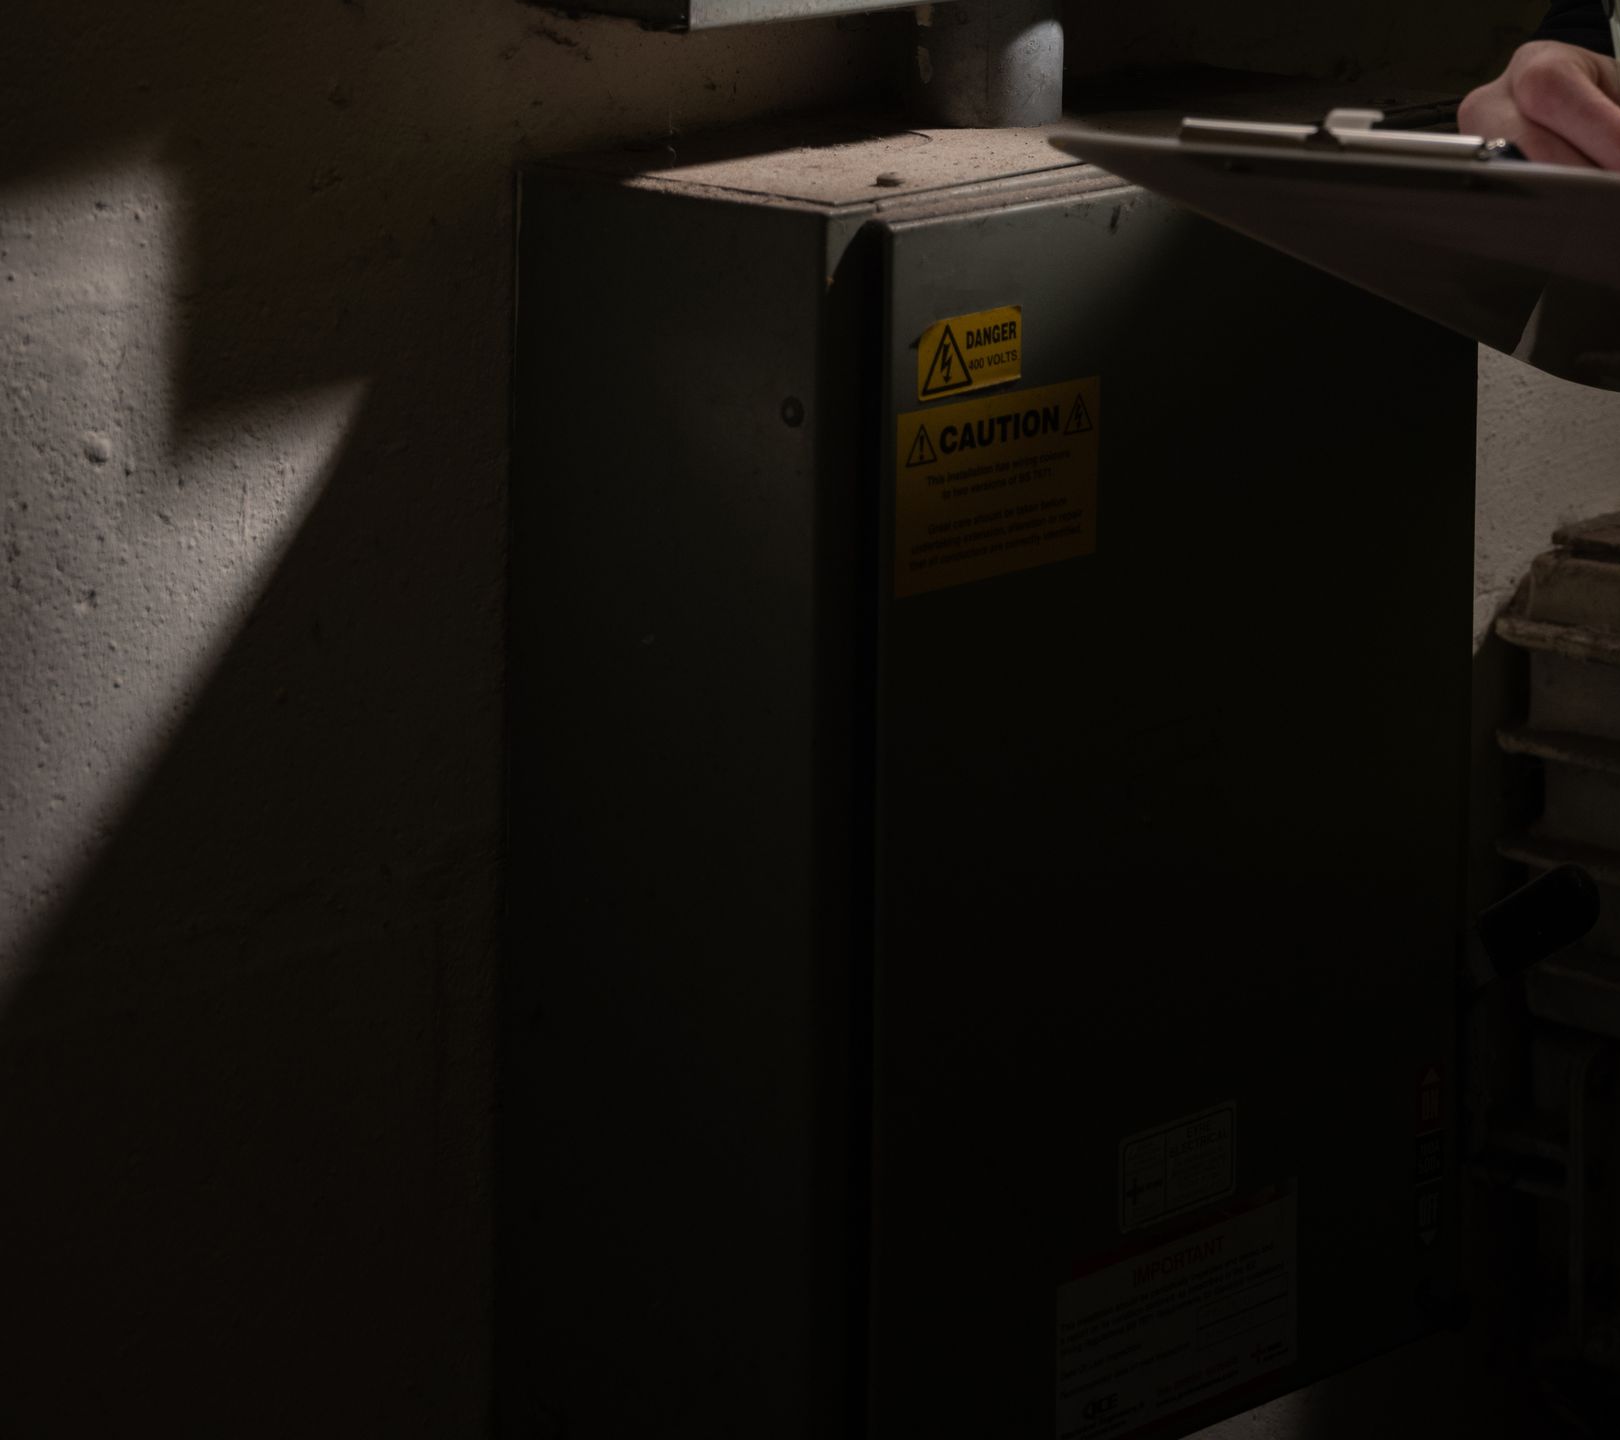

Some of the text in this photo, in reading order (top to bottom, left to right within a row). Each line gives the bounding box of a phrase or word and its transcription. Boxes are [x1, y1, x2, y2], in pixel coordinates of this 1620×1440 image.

[966, 321, 1018, 350] DANGER
[968, 350, 1018, 372] 400 VOLTS
[939, 405, 1060, 456] CAUTION
